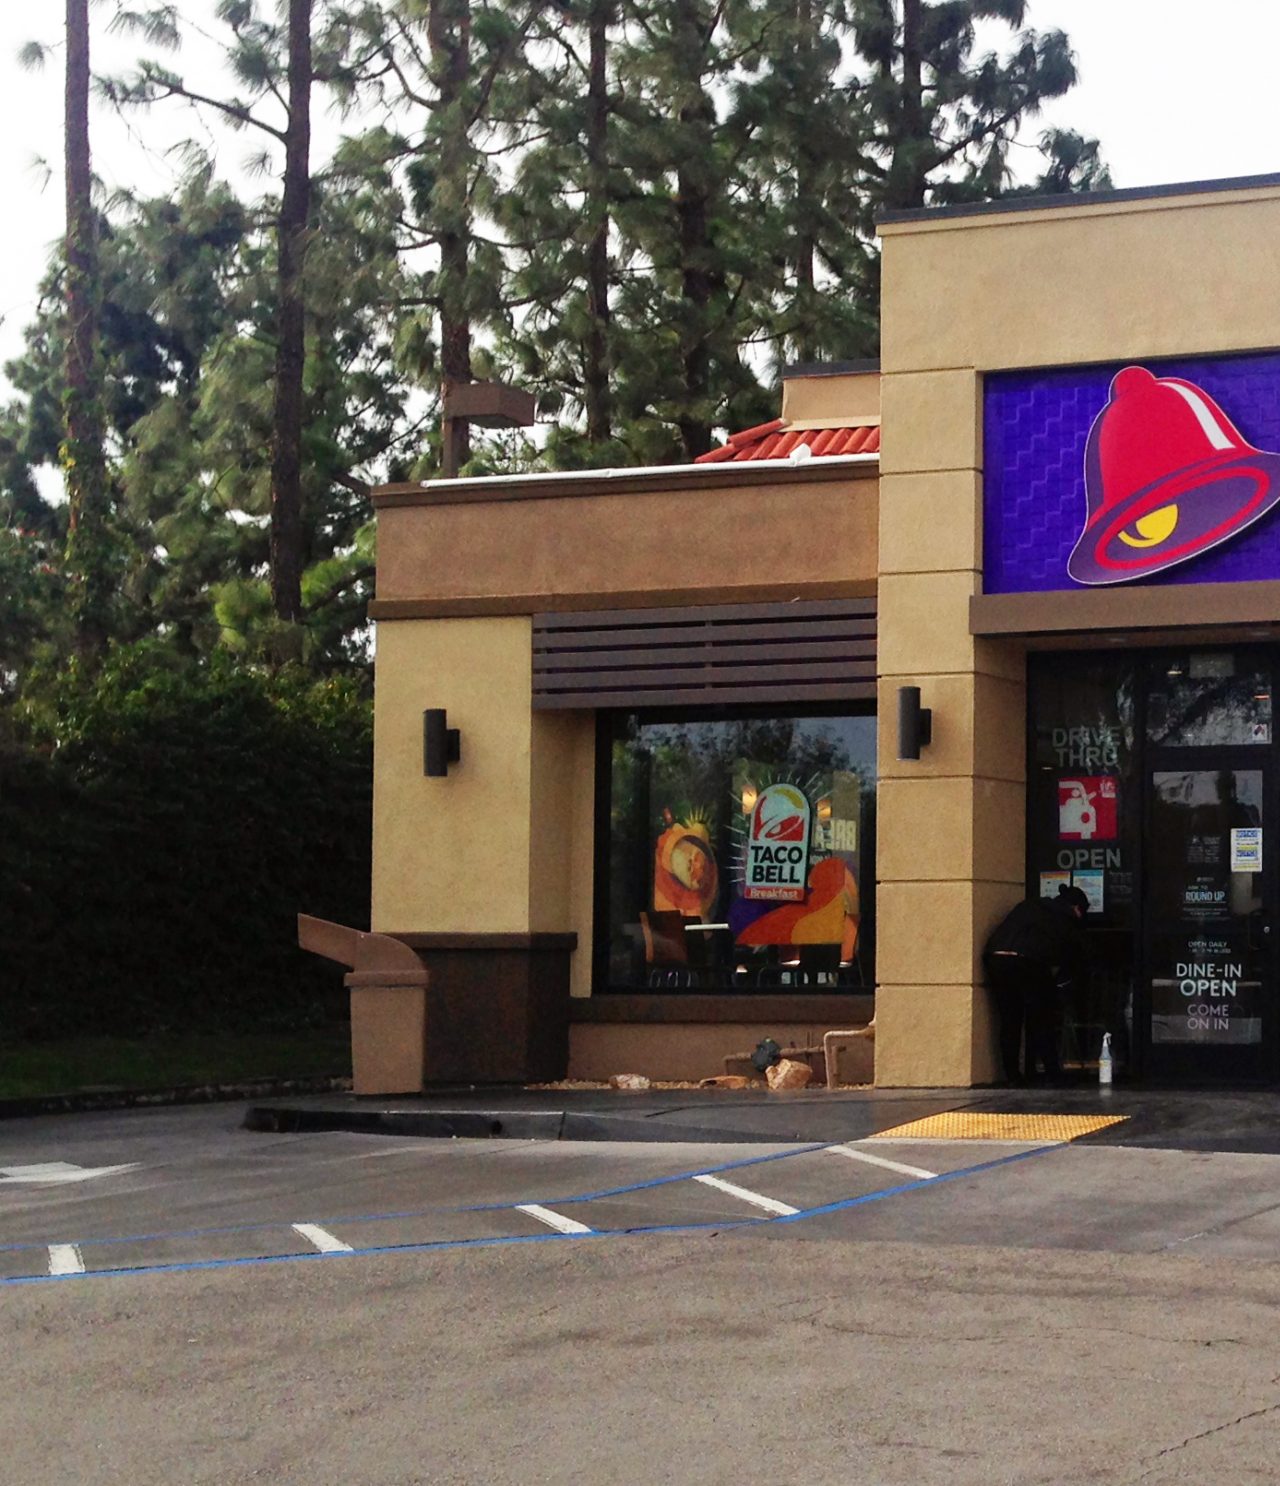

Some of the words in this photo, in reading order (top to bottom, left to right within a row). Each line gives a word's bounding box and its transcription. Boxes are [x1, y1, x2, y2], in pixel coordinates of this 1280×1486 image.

[1053, 726, 1121, 748] DRIVE
[750, 845, 803, 864] TACO
[1057, 848, 1121, 869] OPEN
[752, 865, 800, 883] BELL
[750, 888, 798, 899] Breakfast
[1185, 891, 1212, 901] ROUND
[1214, 891, 1225, 901] UP
[1176, 963, 1242, 978] DINE-IN
[1180, 979, 1237, 997] OPEN
[1187, 1004, 1229, 1016] COME
[1187, 1018, 1209, 1030] ON
[1214, 1018, 1229, 1030] IN
